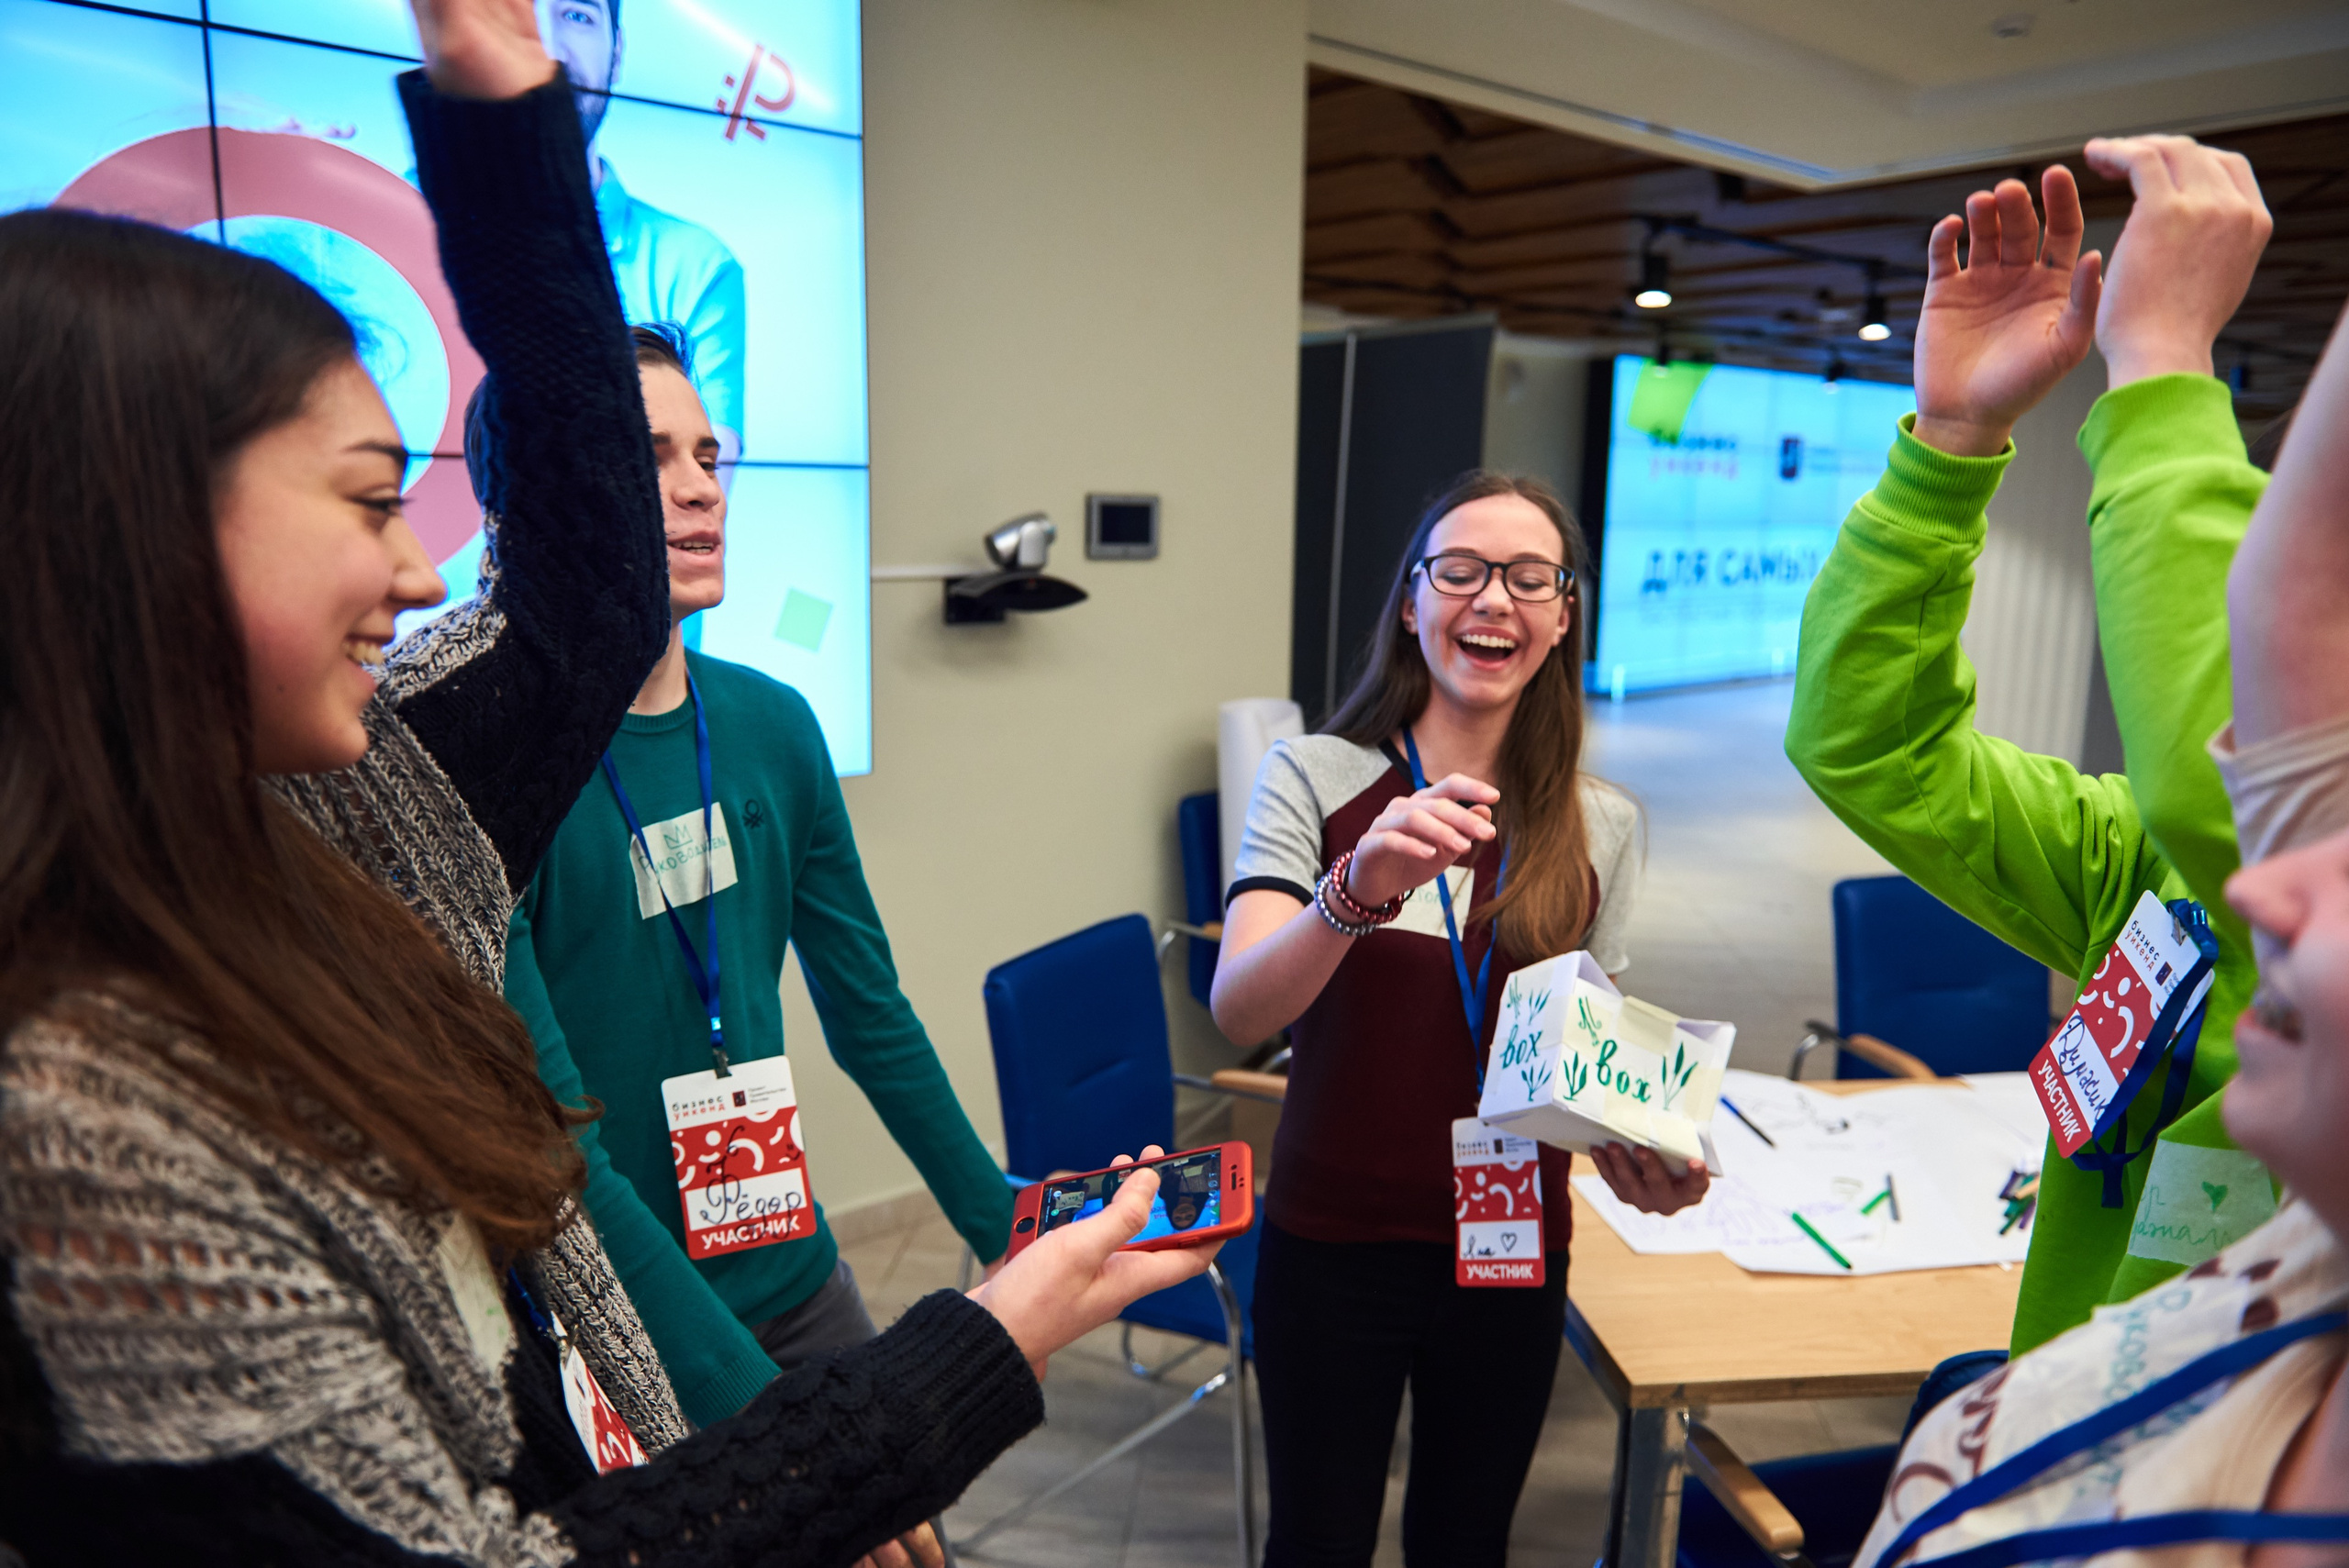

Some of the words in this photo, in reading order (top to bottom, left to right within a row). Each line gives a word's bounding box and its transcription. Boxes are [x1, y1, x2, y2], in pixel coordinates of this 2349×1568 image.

[2124, 929, 2155, 972] уикенд
[2131, 919, 2161, 962] бизнес
[672, 1095, 723, 1112] бизнес
[674, 1103, 726, 1122] уикенд
[2037, 1059, 2081, 1143] УЧАСТНИК
[701, 1215, 801, 1251] УЧАСТНИК
[1466, 1263, 1534, 1280] УЧАСТНИК
